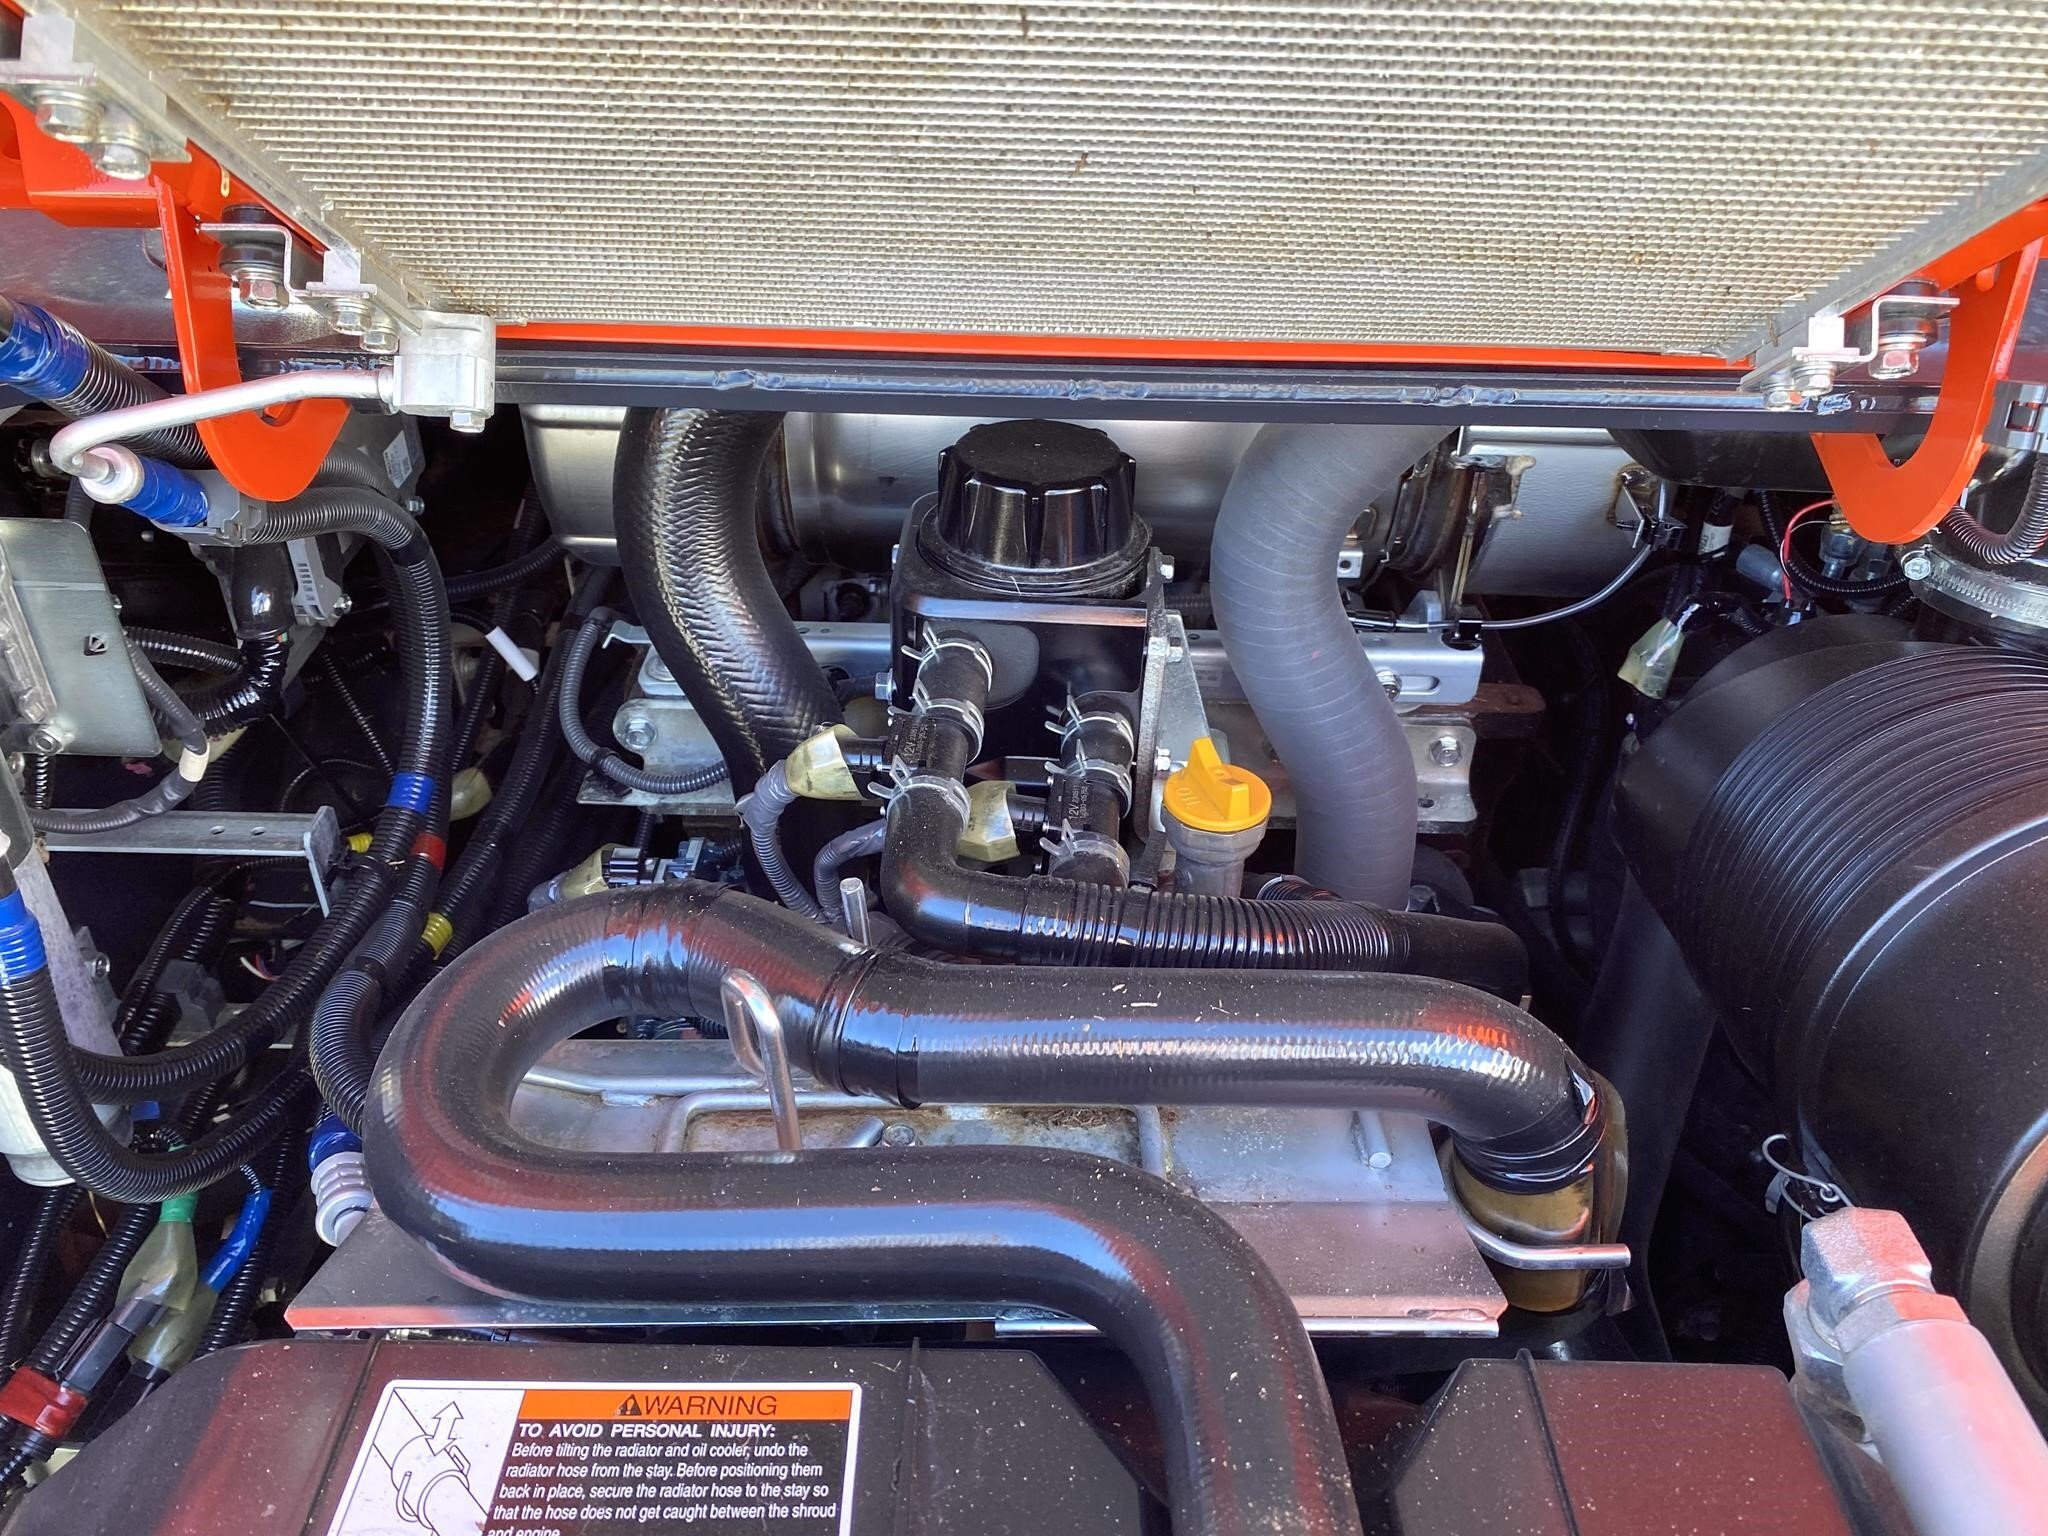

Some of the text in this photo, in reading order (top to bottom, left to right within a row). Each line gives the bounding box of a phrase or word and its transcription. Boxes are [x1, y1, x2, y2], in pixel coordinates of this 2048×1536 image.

[1176, 787, 1201, 809] OIL
[1069, 803, 1079, 819] 12V
[645, 1395, 777, 1416] WARNING
[519, 1423, 776, 1438] TO AVOID PERSONAL INJURY:
[512, 1442, 809, 1460] Before tilting the radiator and oil cooler, undo the
[505, 1462, 823, 1480] radiator hose from the stay. Before positioning them
[499, 1483, 829, 1502] back in place, secure the radiator hose to the stay so
[493, 1502, 837, 1523] that the hose does not get caught between the shroud
[487, 1526, 514, 1536] and
